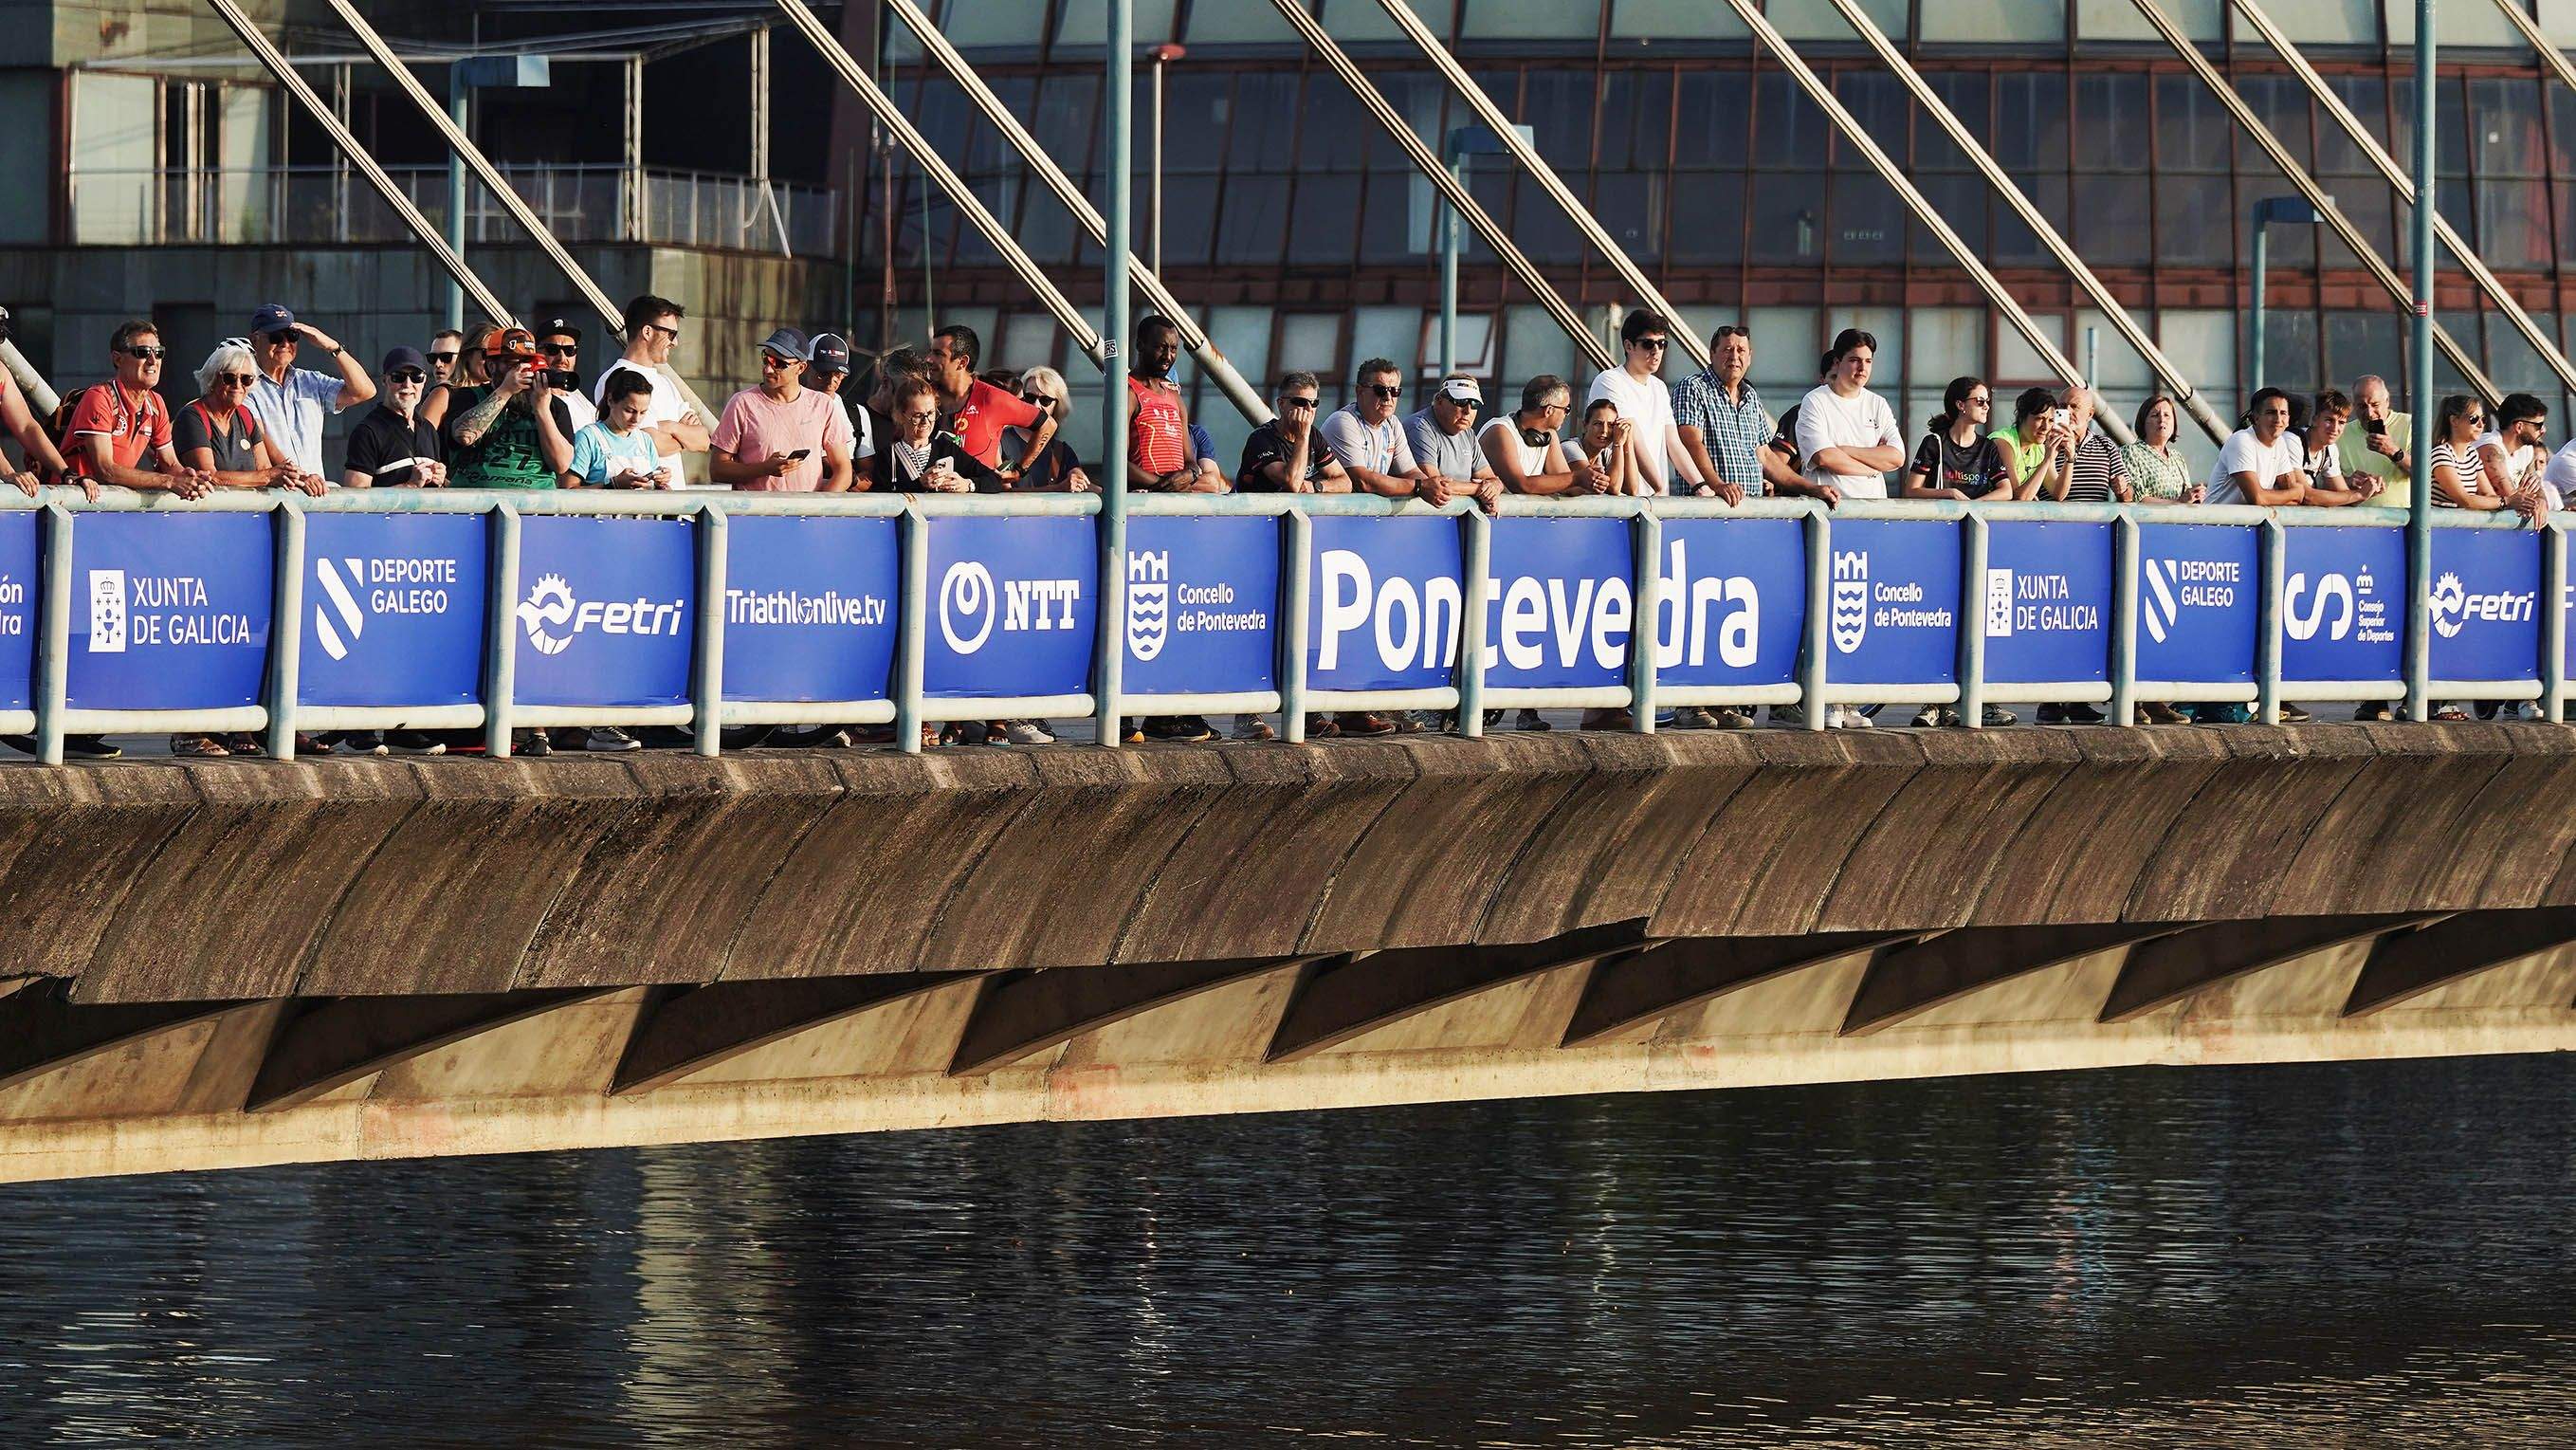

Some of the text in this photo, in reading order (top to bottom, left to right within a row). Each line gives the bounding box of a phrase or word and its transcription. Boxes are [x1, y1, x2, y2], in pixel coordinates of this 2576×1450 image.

[371, 559, 457, 584] DEPORTE
[2181, 560, 2240, 582] DEPORTE
[133, 577, 209, 608] XUNTA
[1177, 582, 1234, 605] Concello
[1874, 581, 1924, 602] Concello
[2017, 575, 2070, 600] XUNTA
[2181, 585, 2234, 608] GALEGO
[371, 589, 448, 615] GALEGO
[726, 589, 886, 626] Triathlonlive.tv
[1004, 579, 1080, 631] NTT
[2358, 599, 2384, 618] Consejo
[1177, 608, 1267, 633] de Pontevedra
[1873, 607, 1952, 628] de Pontevedra
[2016, 602, 2098, 631] DE GALICIA
[2358, 614, 2385, 629] Superior
[134, 614, 250, 645] DE GALICIA
[2357, 628, 2395, 644] de Deportes
